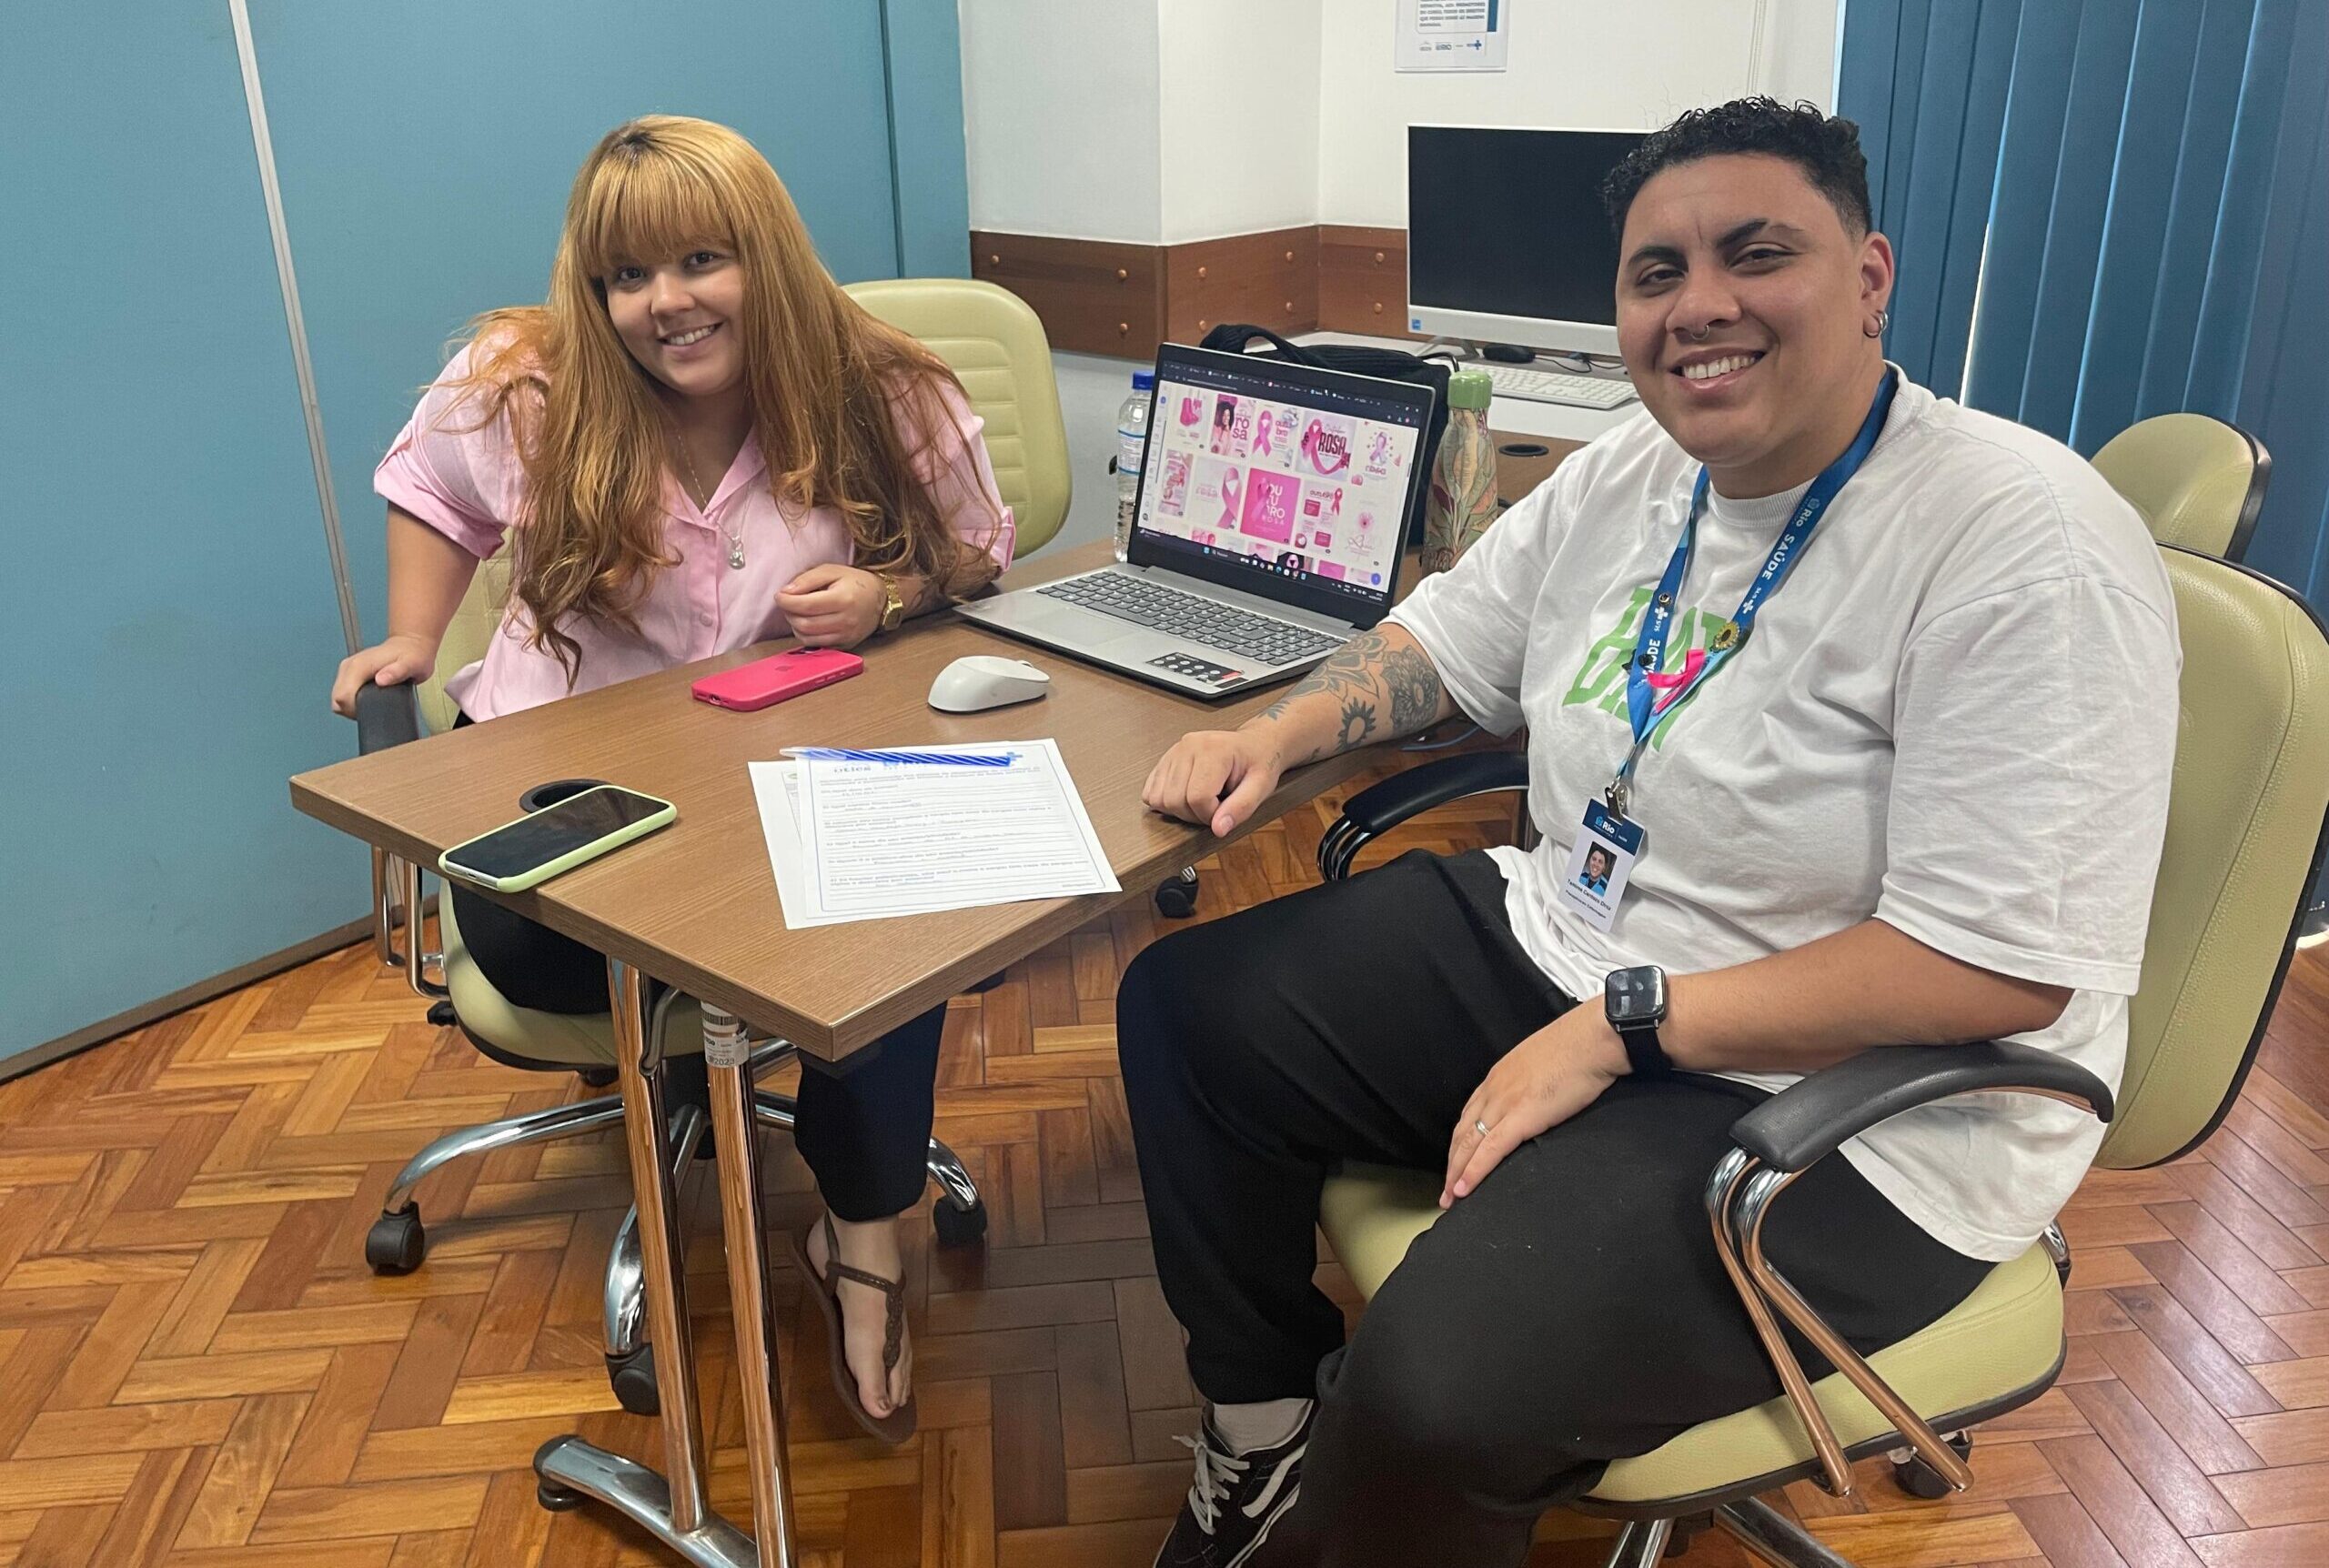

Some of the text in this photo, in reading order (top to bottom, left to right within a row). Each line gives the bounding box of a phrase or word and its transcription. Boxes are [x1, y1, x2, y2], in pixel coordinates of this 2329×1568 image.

[1317, 432, 1347, 457] ROSA
[1796, 508, 1813, 527] Rio
[1762, 534, 1795, 580] SAÚDE
[1601, 821, 1616, 835] Rio
